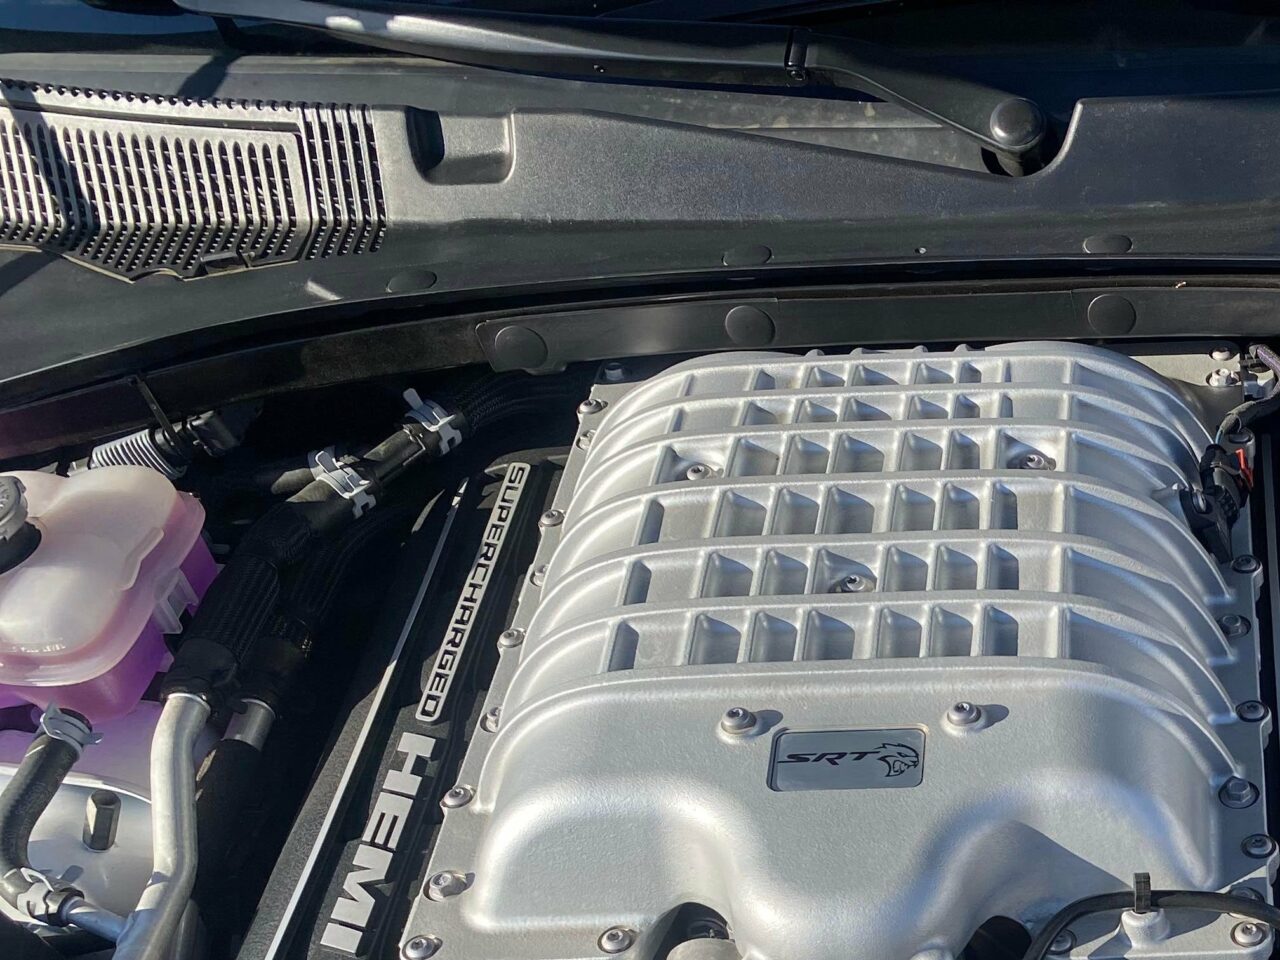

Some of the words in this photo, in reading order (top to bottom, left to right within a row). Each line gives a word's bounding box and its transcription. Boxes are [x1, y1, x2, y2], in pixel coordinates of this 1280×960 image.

[418, 464, 529, 719] SUPERCHARGED
[319, 732, 436, 954] HEMI
[777, 750, 881, 766] SRT
